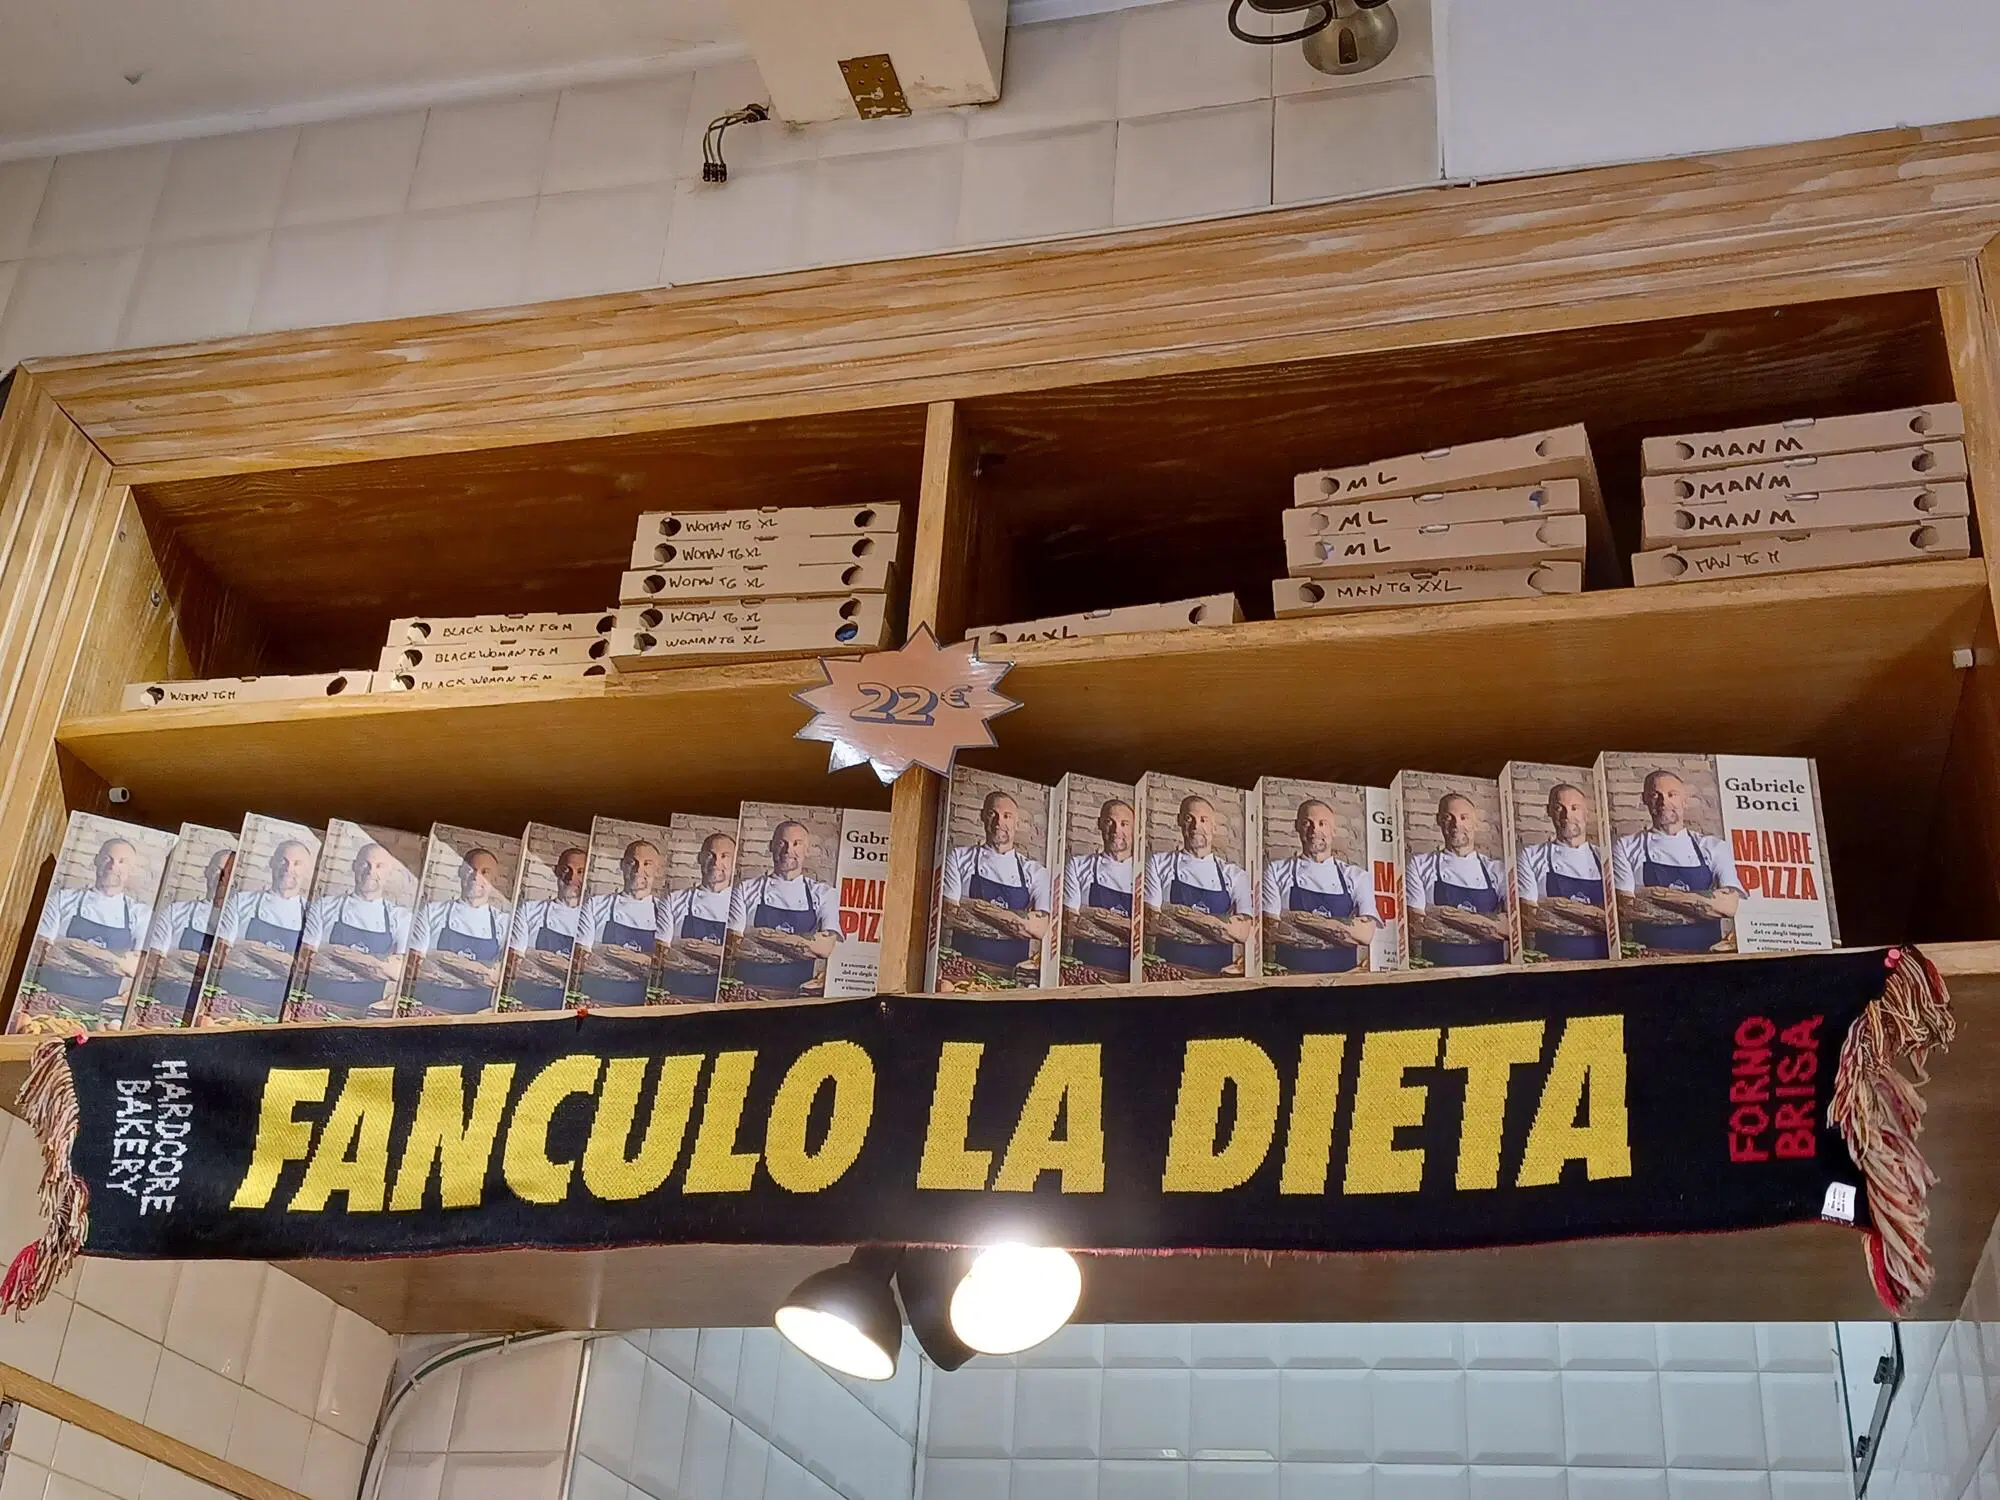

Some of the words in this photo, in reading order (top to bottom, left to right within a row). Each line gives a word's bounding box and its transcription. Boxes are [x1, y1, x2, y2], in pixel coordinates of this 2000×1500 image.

[1701, 439, 1766, 459] MAN
[1775, 437, 1803, 452] M
[1699, 471, 1765, 499] MAN
[686, 520, 732, 533] WOMAN
[736, 520, 751, 531] TG
[758, 518, 778, 529] XL
[1699, 509, 1761, 530] MAN
[1769, 509, 1796, 524] M
[682, 547, 724, 561] WOMAN
[728, 548, 744, 560] TG
[745, 547, 762, 558] XL
[1695, 553, 1730, 573] MAN
[669, 575, 714, 588] WOMAN
[719, 576, 737, 589] TG
[746, 577, 765, 588] XL
[1337, 583, 1383, 598] MAN
[1387, 581, 1410, 593] TG
[1417, 579, 1462, 593] XXL
[670, 610, 716, 623] WOMAN
[443, 624, 483, 638] BLACK
[490, 622, 535, 633] WOMAN
[665, 635, 717, 648] WOMAN
[719, 635, 735, 645] TG
[743, 634, 765, 644] XL
[435, 651, 477, 663] BLACK
[479, 648, 526, 658] WOMAN
[470, 674, 516, 685] WOMAN
[850, 681, 974, 726] 22€
[1725, 777, 1805, 794] Gabriele
[1735, 795, 1800, 812] Bonci
[1731, 829, 1815, 865] MADRE
[1734, 864, 1819, 901] PIZZA
[1728, 1016, 1776, 1162] FORNO
[1775, 1014, 1824, 1158] BRISA
[229, 1040, 875, 1213] FANCULO
[916, 1041, 1106, 1194] LA
[1161, 1014, 1633, 1195] DIETA
[106, 1080, 153, 1196] BAKERY
[140, 1060, 193, 1216] HARDCORE
